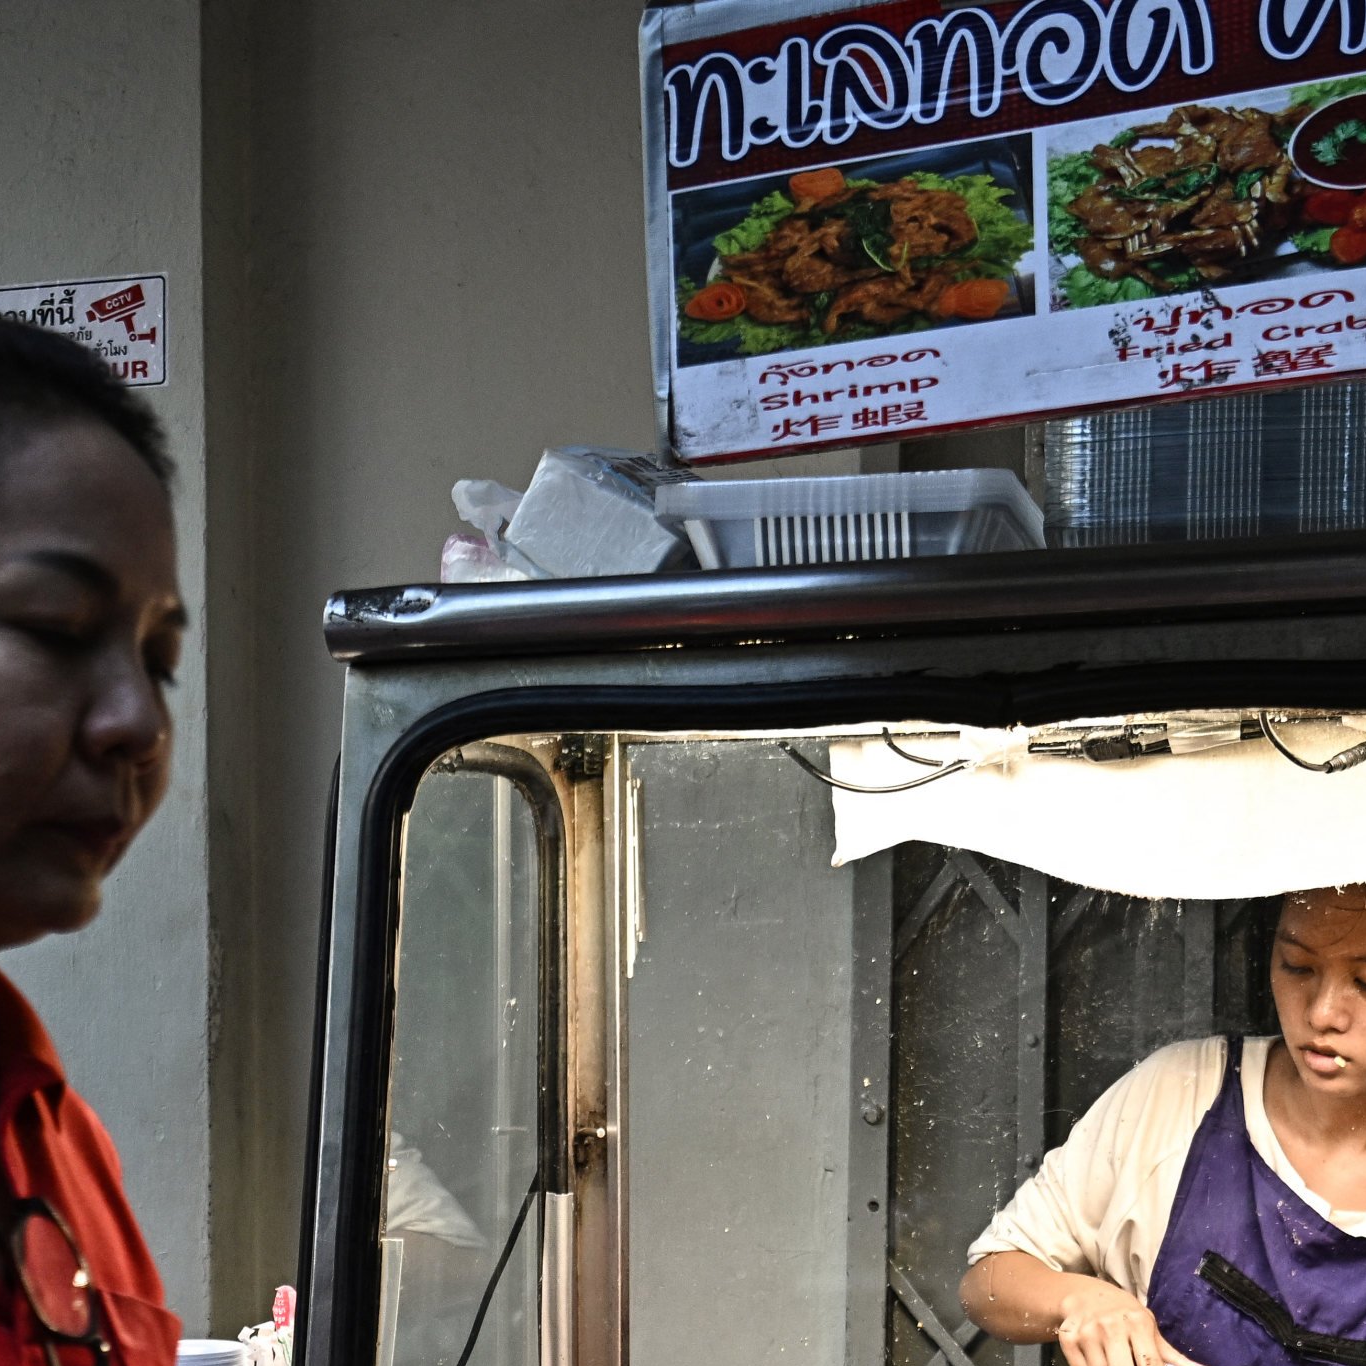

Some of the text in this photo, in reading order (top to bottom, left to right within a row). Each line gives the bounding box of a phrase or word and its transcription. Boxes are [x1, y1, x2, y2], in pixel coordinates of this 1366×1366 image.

[665, 0, 1214, 168] ทะเลทอด
[104, 292, 132, 310] CCTV
[1133, 289, 1355, 336] ปูทอด
[1116, 333, 1232, 362] Fried
[758, 348, 941, 386] กุ้งทอด
[759, 376, 940, 411] Shrimp
